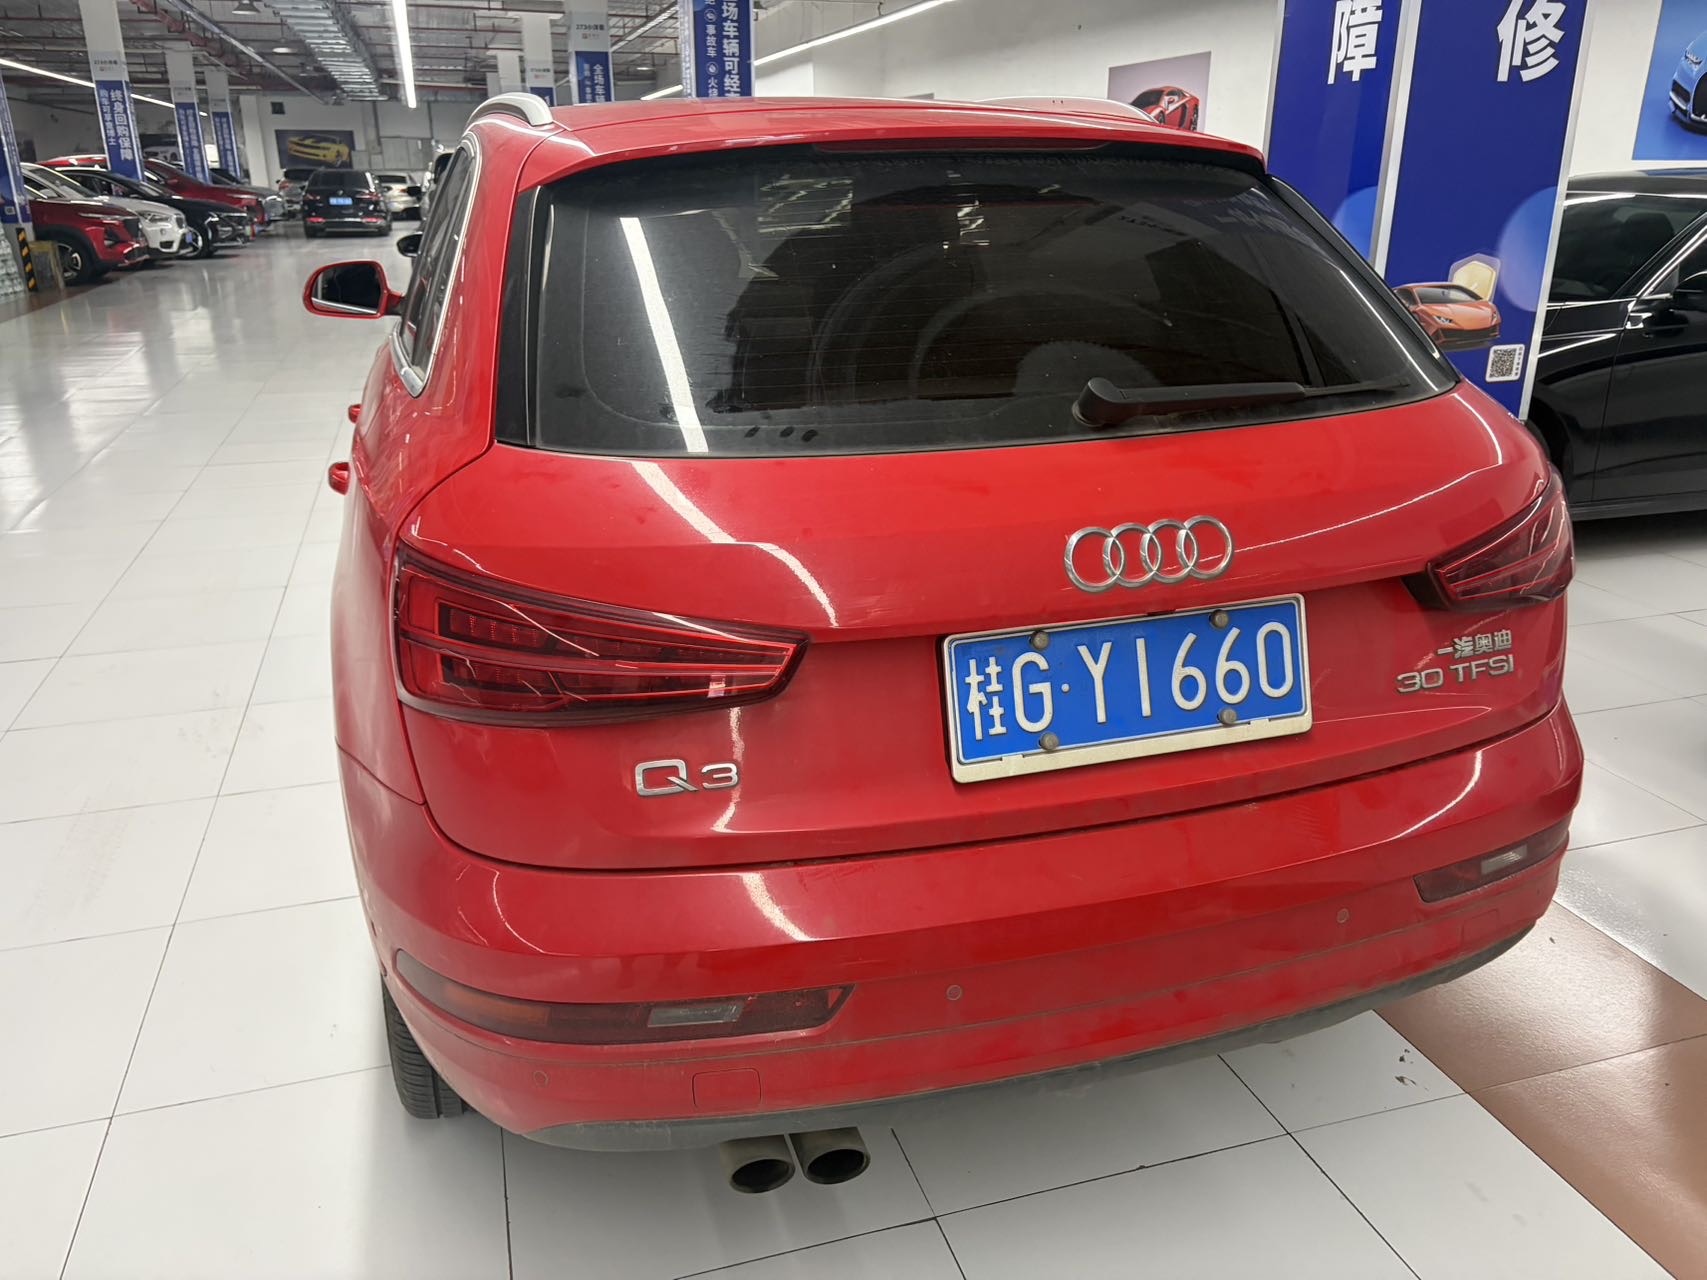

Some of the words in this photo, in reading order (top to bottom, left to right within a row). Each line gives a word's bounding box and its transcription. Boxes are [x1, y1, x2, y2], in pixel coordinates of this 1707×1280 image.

[1327, 0, 1382, 84] 障
[1497, 0, 1566, 82] 修
[110, 89, 134, 161] 终身回购保障
[1437, 629, 1513, 660] 一汽奥迪
[1397, 668, 1444, 693] 30
[1449, 653, 1515, 683] TFSI
[634, 758, 739, 796] Q3
